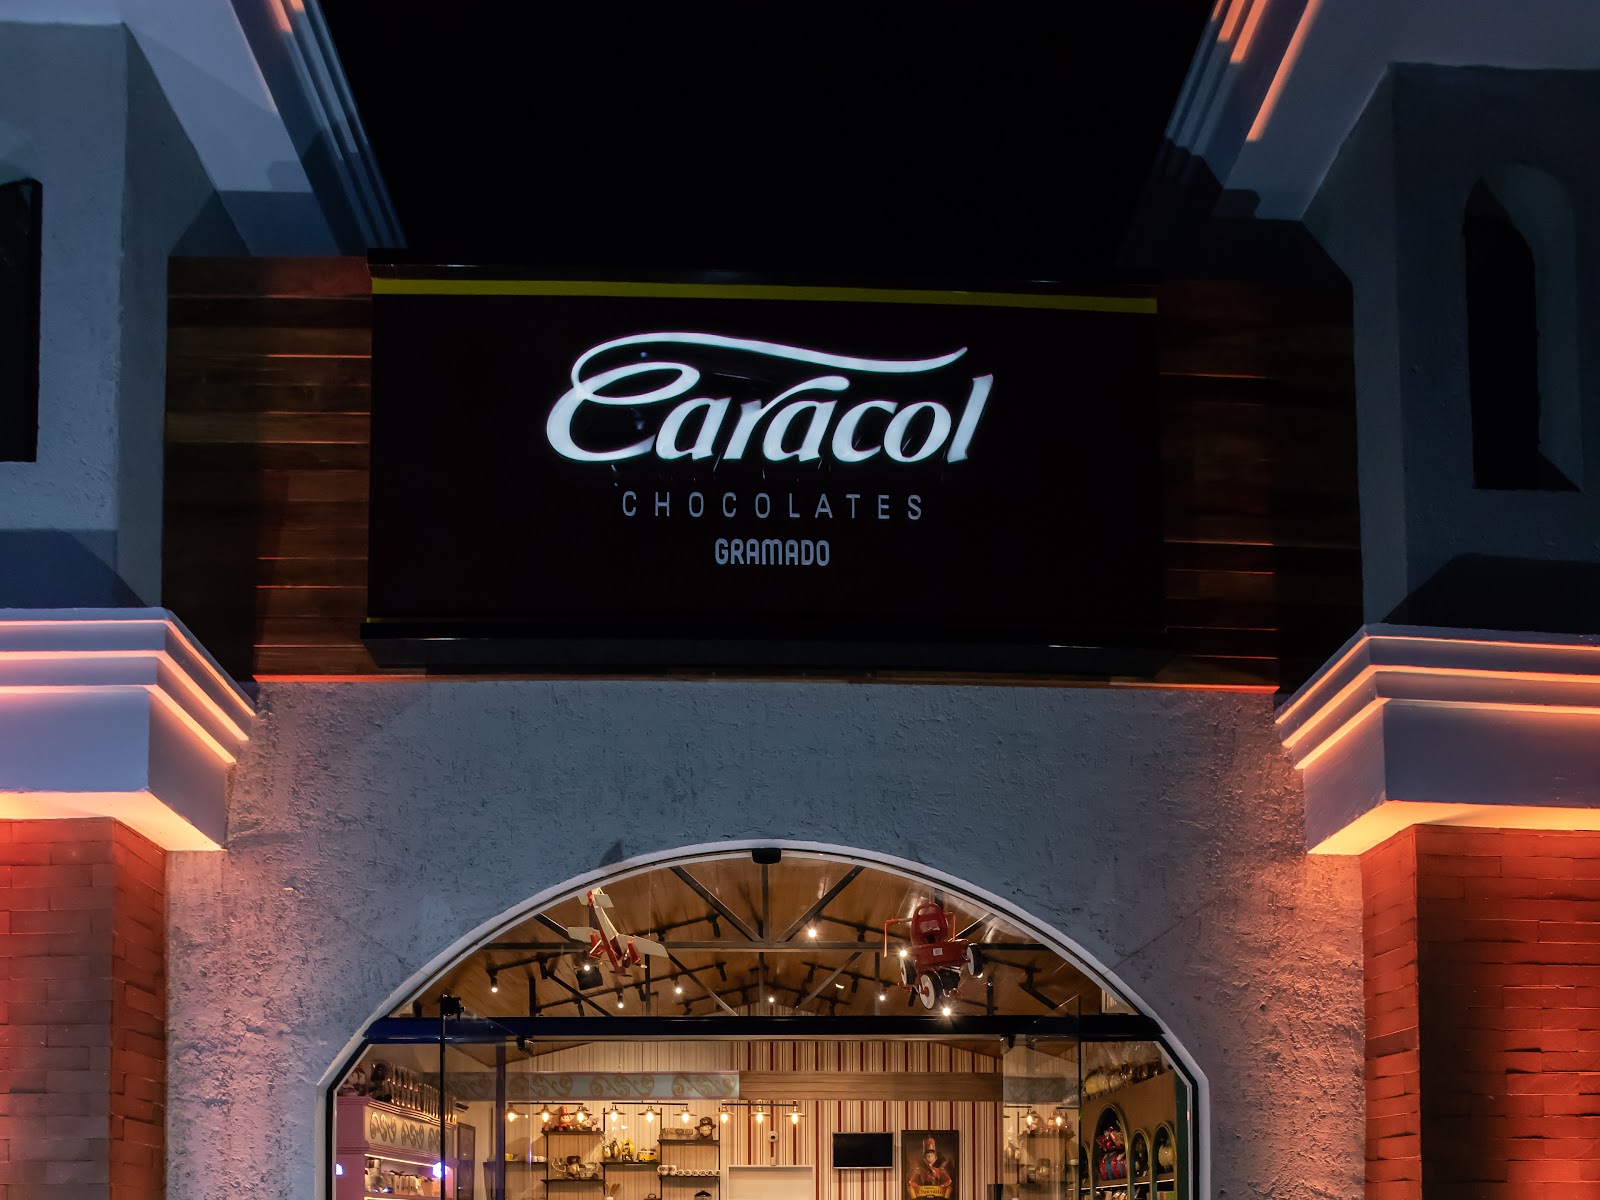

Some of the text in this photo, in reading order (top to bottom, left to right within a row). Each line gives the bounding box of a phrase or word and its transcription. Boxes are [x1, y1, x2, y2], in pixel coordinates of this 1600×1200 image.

[545, 331, 994, 464] Caracol
[621, 490, 923, 521] CHOCOLATES
[714, 537, 831, 567] GRAMADO
